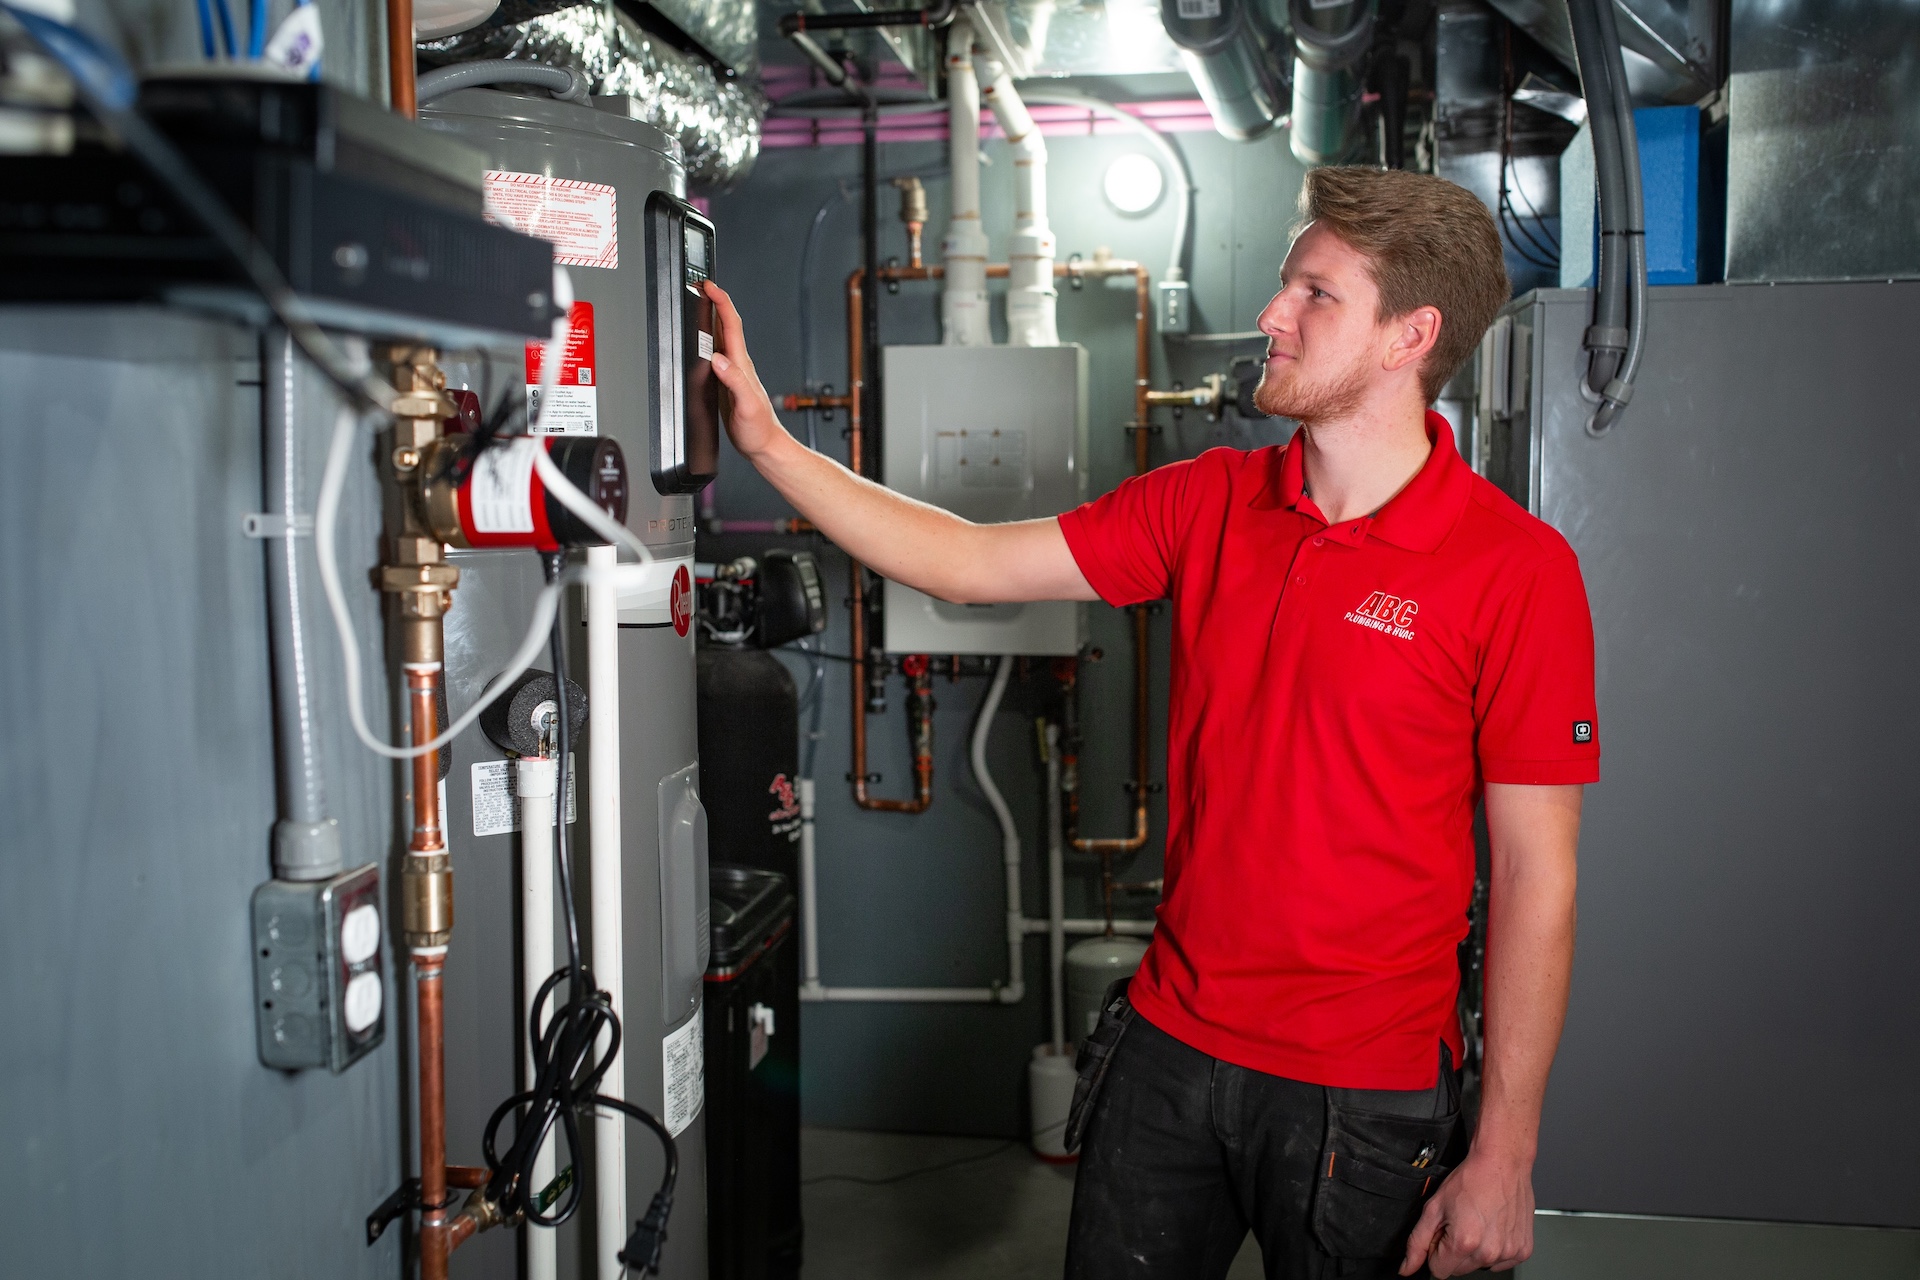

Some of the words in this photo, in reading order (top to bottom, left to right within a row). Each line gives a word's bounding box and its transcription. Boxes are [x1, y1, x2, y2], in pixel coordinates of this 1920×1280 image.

[1356, 591, 1418, 628] ABC
[1344, 612, 1385, 632] PLUMBING
[1384, 625, 1393, 634] &
[1392, 627, 1415, 640] HVAC
